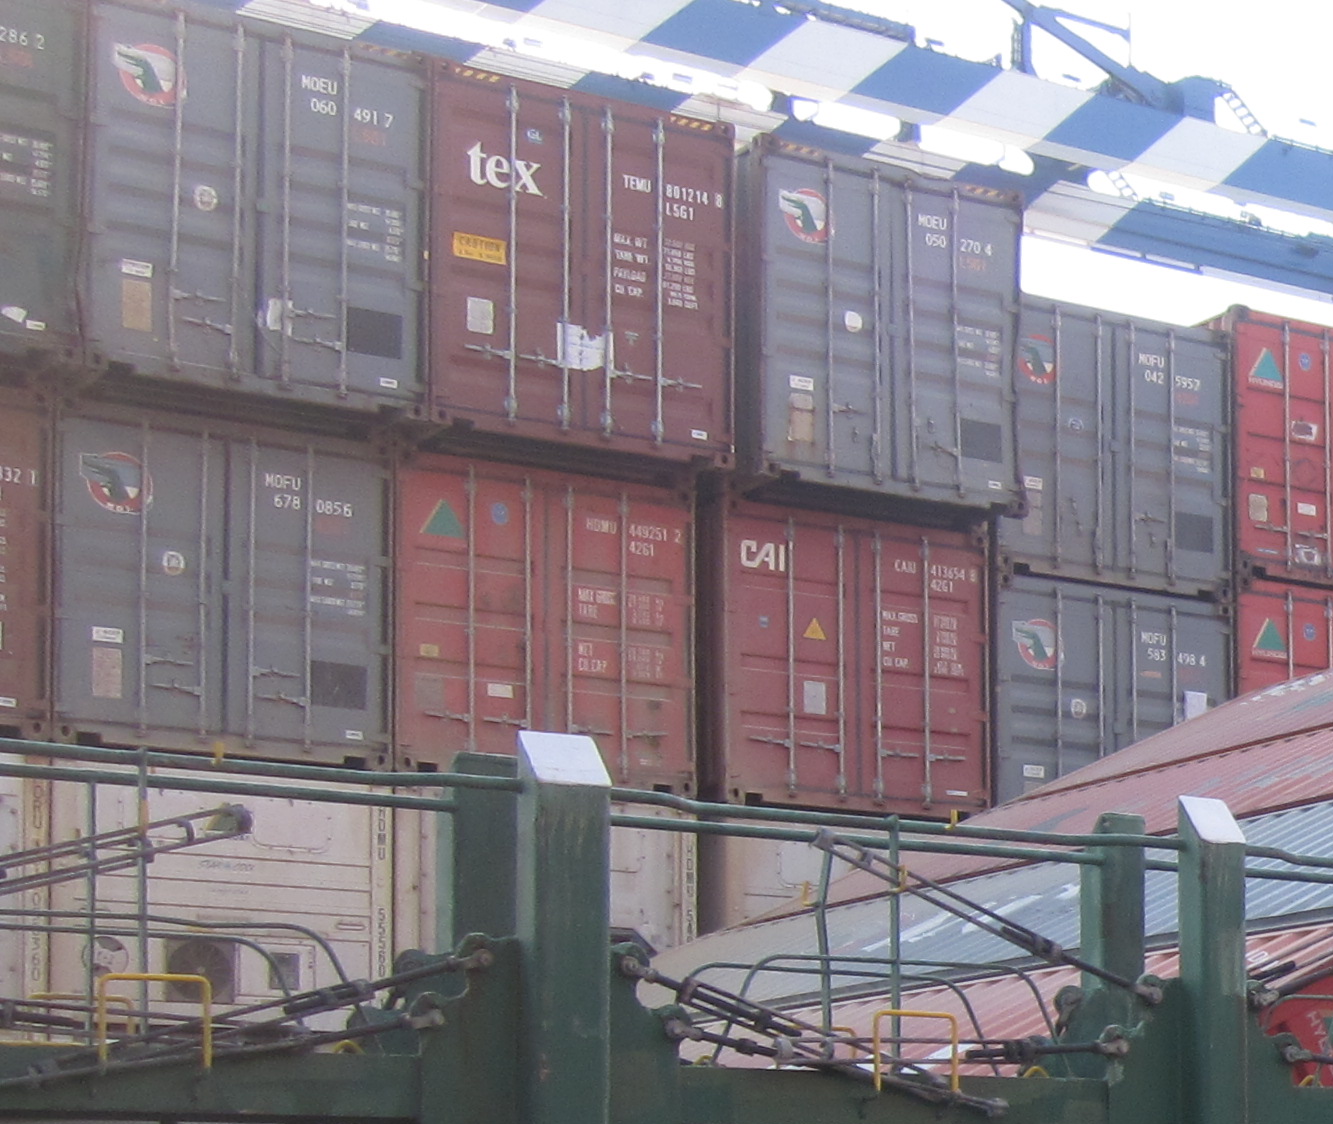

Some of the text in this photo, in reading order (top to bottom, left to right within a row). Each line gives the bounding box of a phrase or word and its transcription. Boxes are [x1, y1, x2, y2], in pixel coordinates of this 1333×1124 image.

[302, 75, 337, 95] MOEU
[311, 98, 394, 128] 060 491 7
[466, 140, 544, 197] tex
[622, 174, 652, 193] TEMU
[665, 183, 709, 206] 801214
[918, 213, 947, 230] MOEU
[925, 233, 992, 257] 050 270 4
[265, 474, 301, 492] MOFU
[273, 493, 301, 510] 678
[740, 539, 786, 572] CAI
